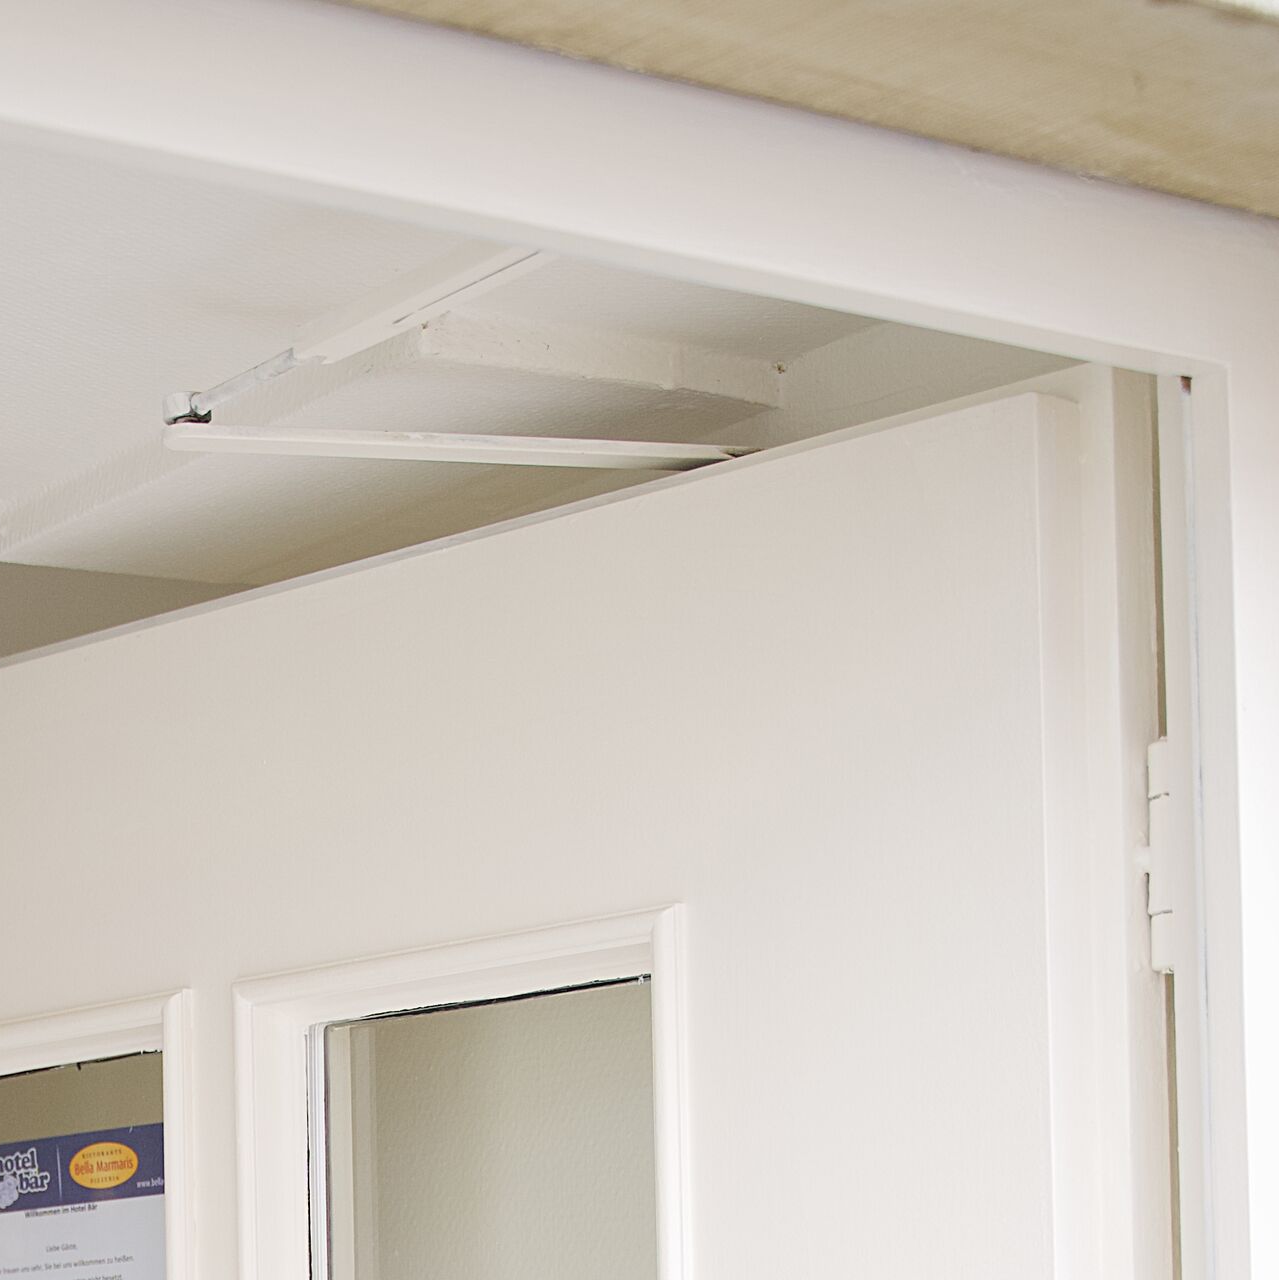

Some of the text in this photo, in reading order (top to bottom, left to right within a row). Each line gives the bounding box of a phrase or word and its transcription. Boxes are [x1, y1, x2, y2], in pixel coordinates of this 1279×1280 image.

[74, 1157, 134, 1176] Bella Marmaris
[19, 1169, 49, 1193] bär
[25, 1208, 61, 1218] Willkommen
[71, 1205, 86, 1213] Hotel
[74, 1258, 105, 1267] willkommen
